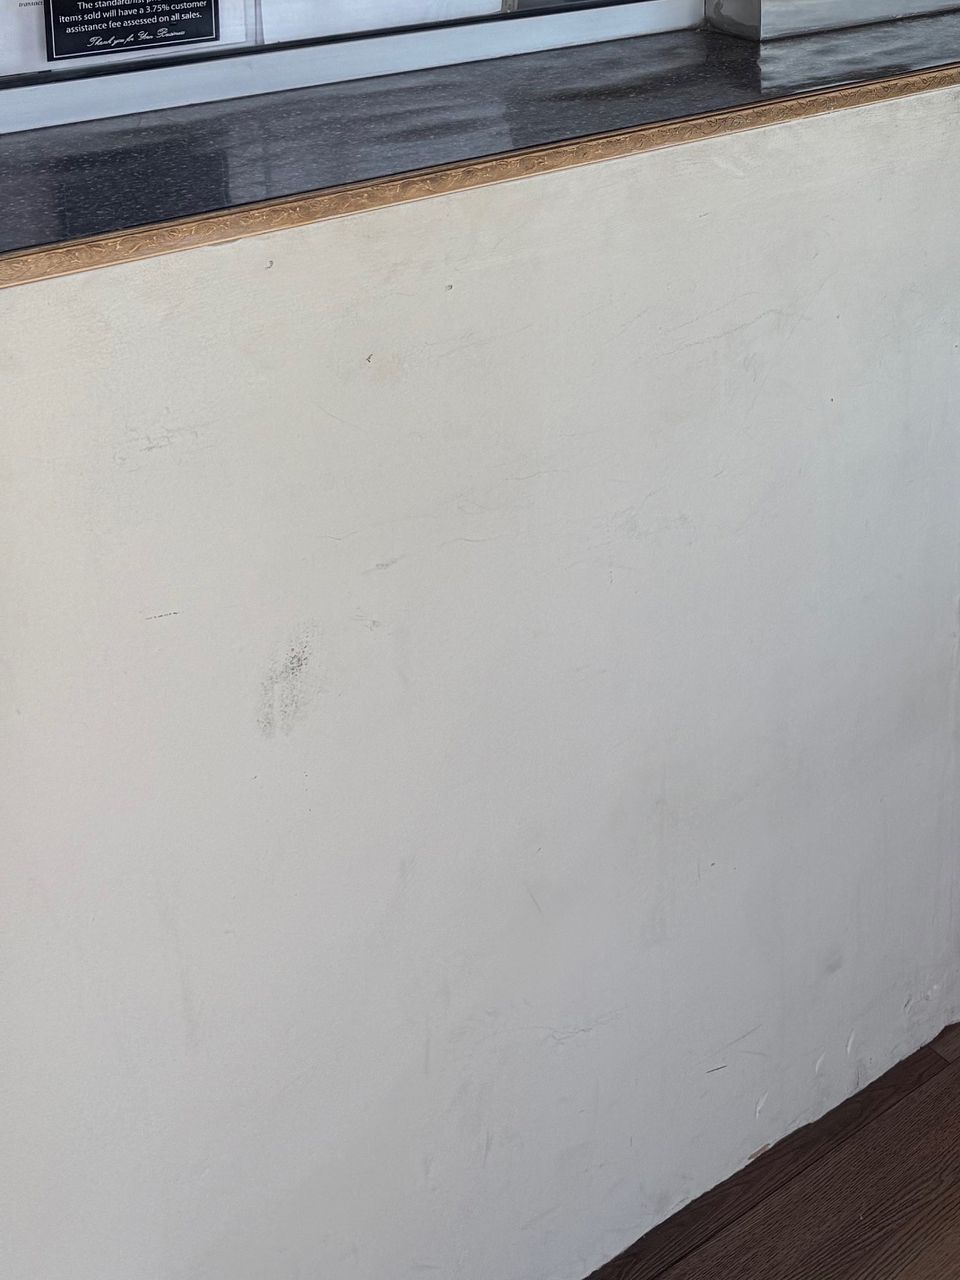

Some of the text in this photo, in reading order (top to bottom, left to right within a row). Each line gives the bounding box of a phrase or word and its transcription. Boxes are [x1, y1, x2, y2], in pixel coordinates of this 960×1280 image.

[59, 14, 82, 23] items
[84, 11, 101, 21] sold
[102, 9, 117, 18] will
[118, 7, 138, 17] have
[145, 3, 170, 13] 3.75%
[170, 0, 207, 10] customer
[77, 1, 93, 10] The
[66, 22, 107, 34] assistance
[109, 19, 122, 28] fee
[123, 16, 157, 27] assessed
[171, 12, 180, 21] all
[181, 11, 202, 19] sales.
